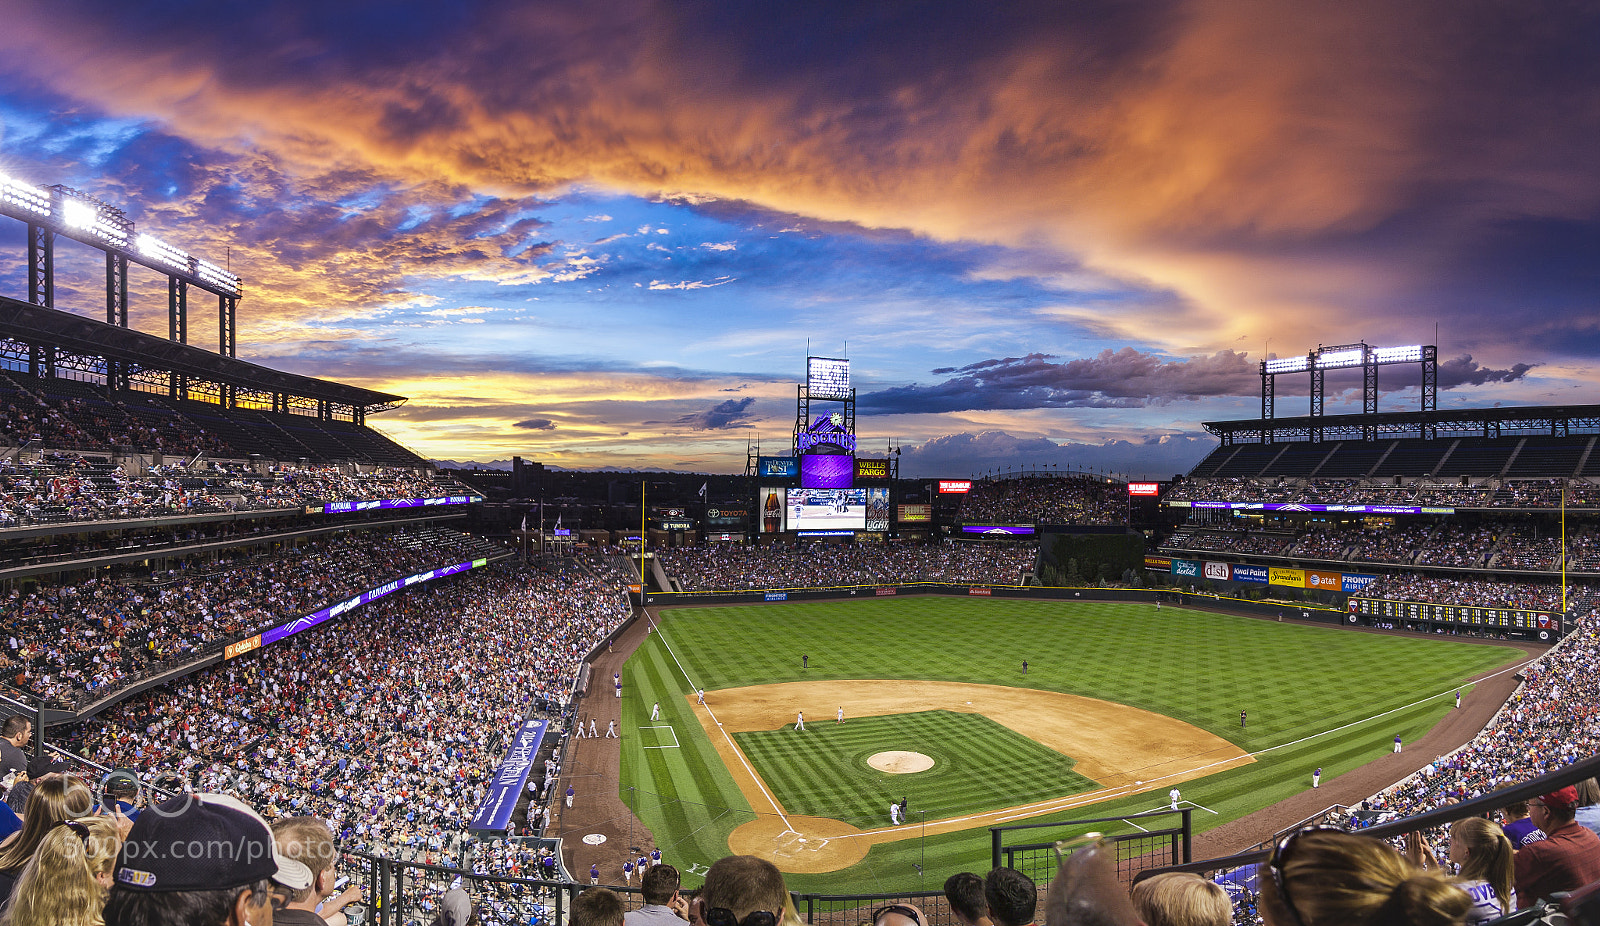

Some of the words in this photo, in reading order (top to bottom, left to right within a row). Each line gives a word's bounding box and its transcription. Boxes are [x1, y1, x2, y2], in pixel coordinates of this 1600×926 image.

[797, 432, 857, 451] ROCKIES
[859, 461, 886, 469] WELLS
[859, 468, 886, 476] FARGO
[1206, 565, 1227, 577] dish
[1234, 567, 1249, 575] Kwal
[1249, 568, 1267, 577] Paint
